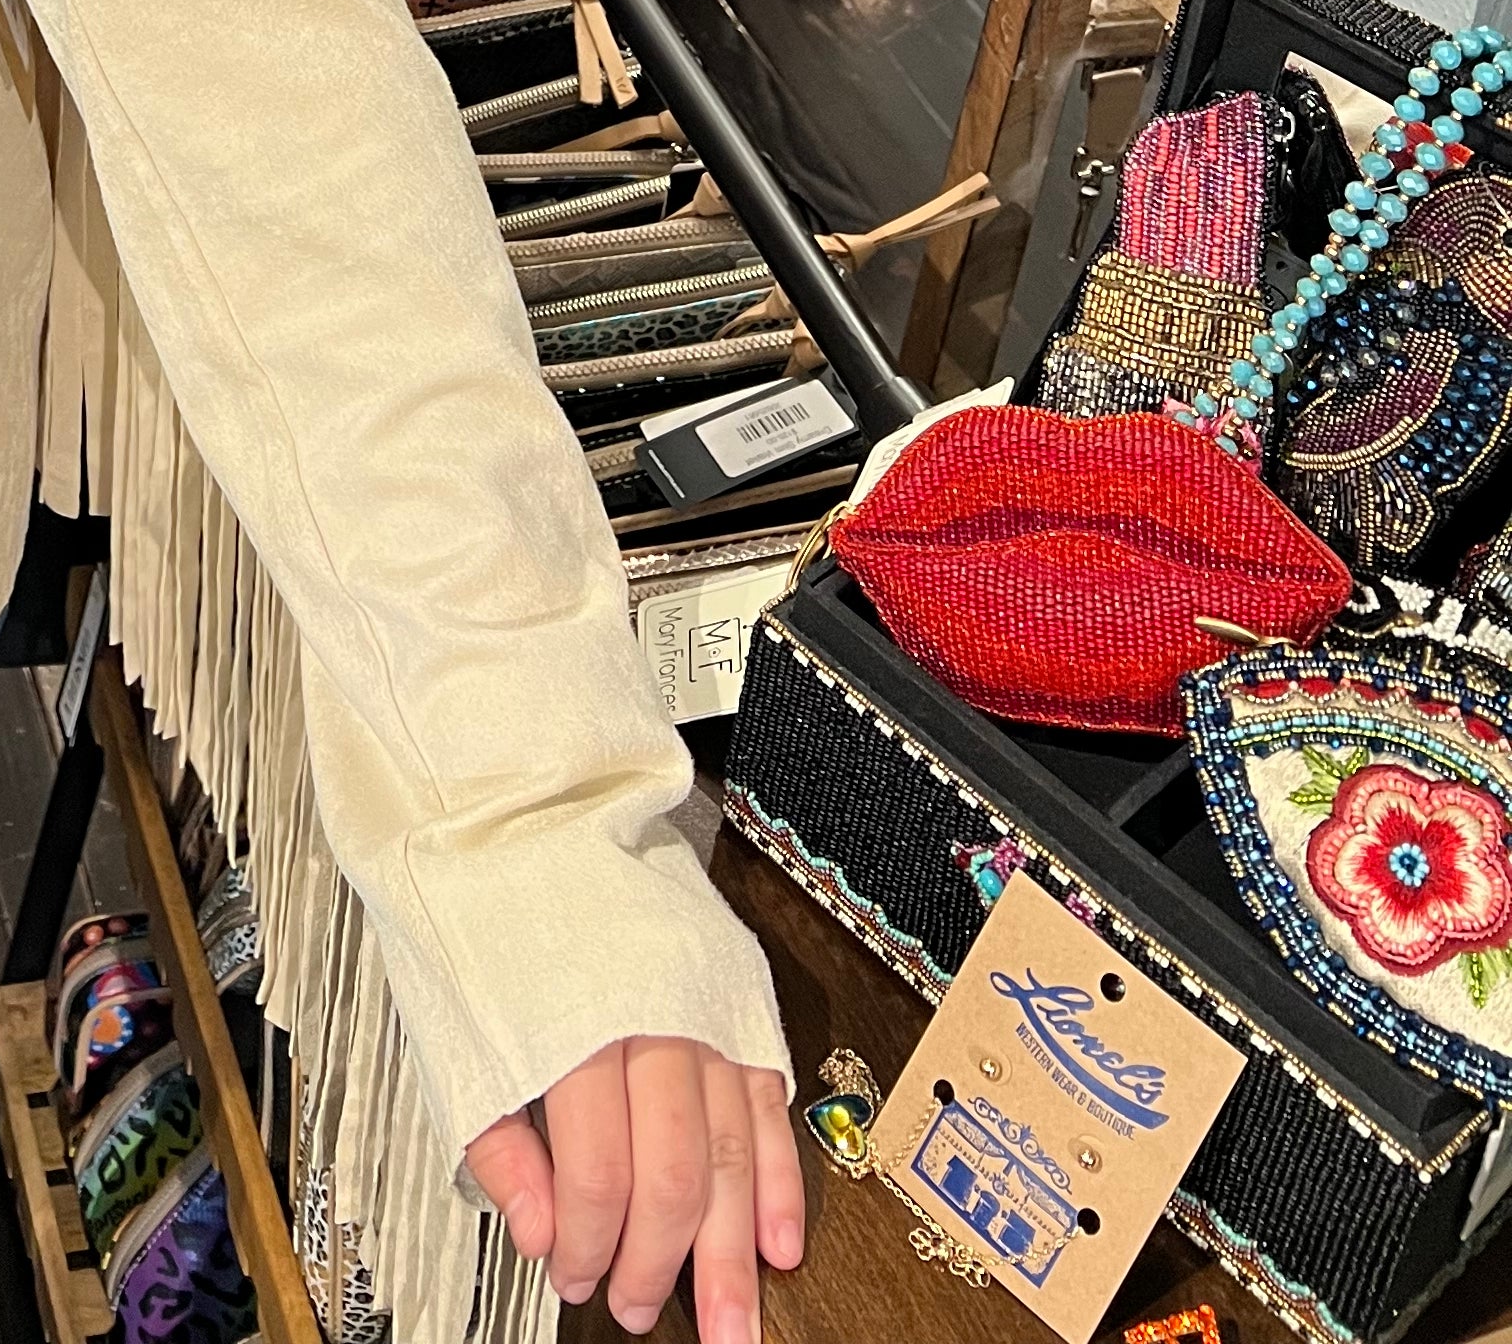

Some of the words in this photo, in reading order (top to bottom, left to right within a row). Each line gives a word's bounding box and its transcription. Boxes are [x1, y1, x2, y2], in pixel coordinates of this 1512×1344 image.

[654, 606, 683, 647] Mary
[990, 967, 1170, 1130] Lionel's
[1015, 1021, 1055, 1073] WESTERN
[1051, 1070, 1079, 1102] WEAR
[1077, 1092, 1088, 1107] &
[1086, 1100, 1138, 1141] BOUTIQUE
